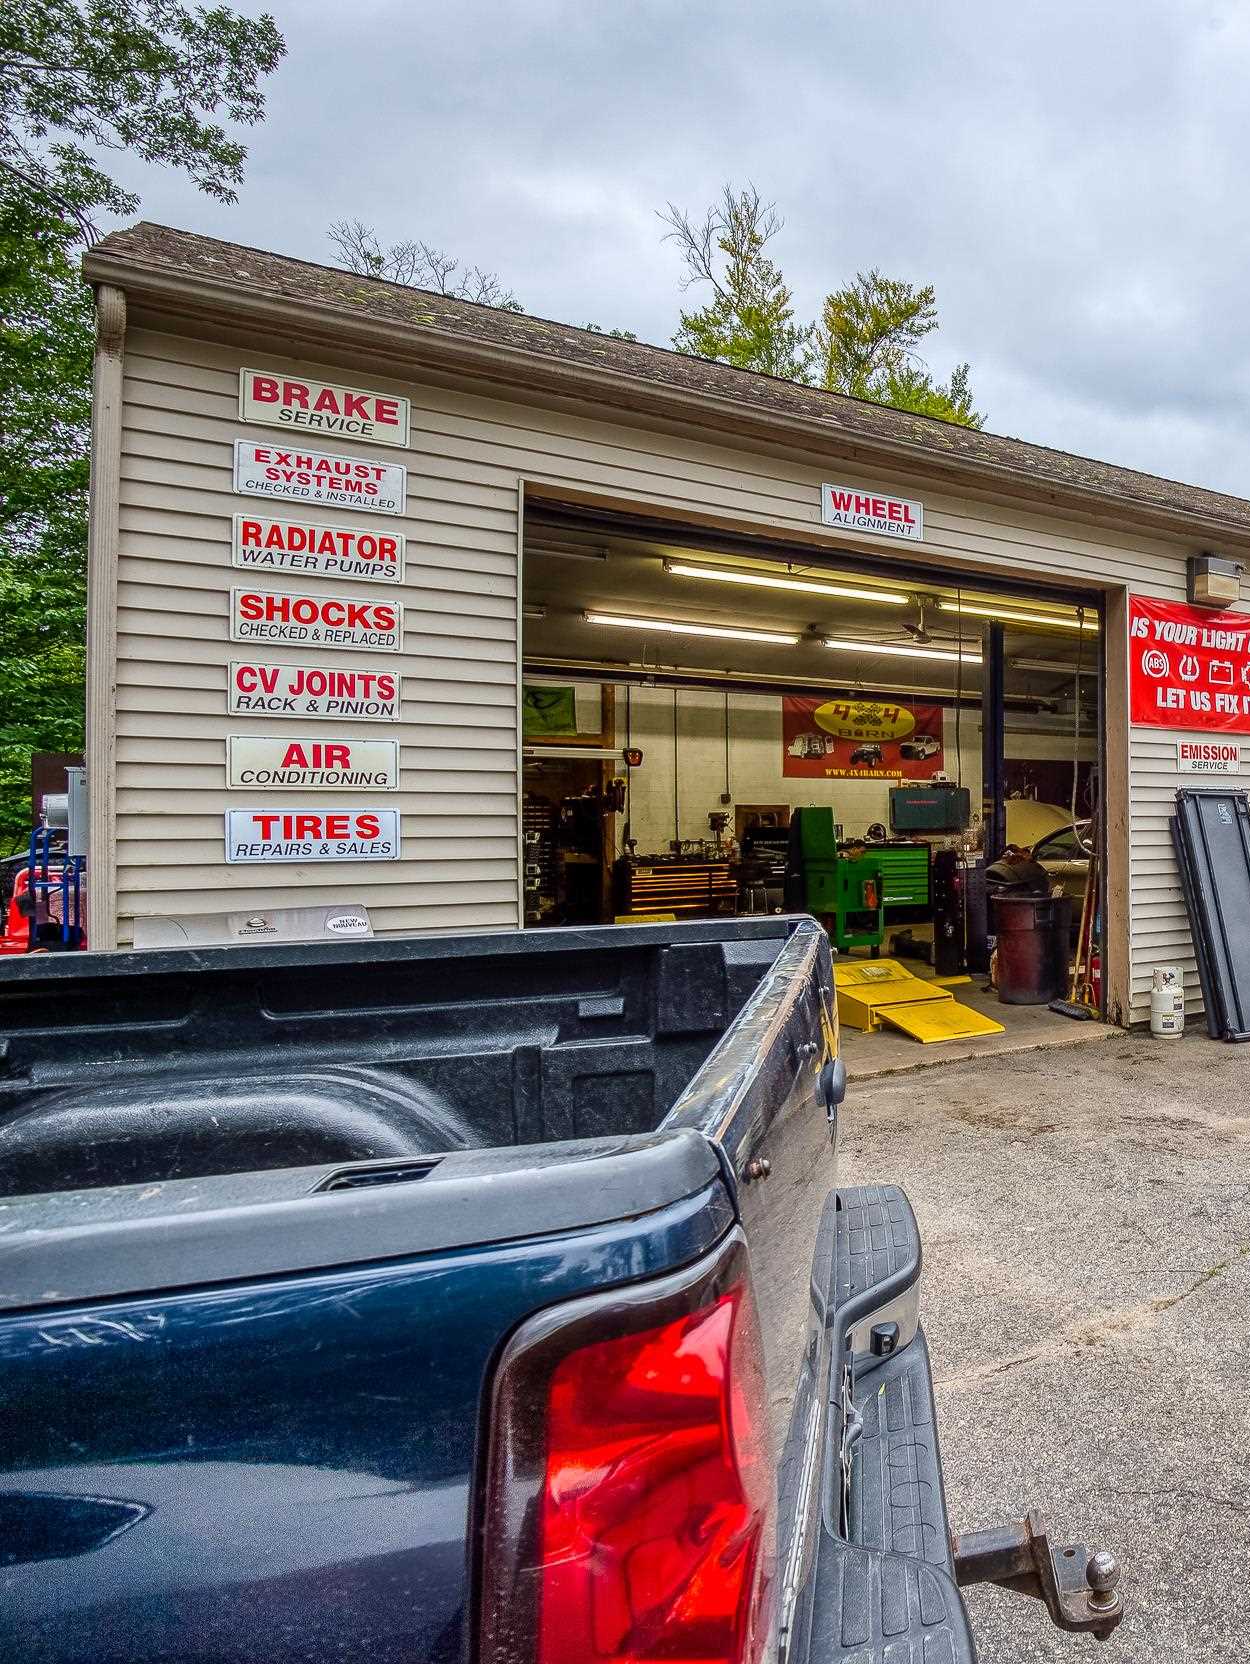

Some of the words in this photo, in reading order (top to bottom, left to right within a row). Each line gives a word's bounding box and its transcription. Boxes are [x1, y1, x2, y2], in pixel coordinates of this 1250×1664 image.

[252, 375, 399, 426] BRAKE
[278, 408, 375, 436] SERVICE
[254, 448, 387, 481] EXHAUST
[245, 479, 310, 497] CHECKED
[314, 490, 323, 499] &
[326, 491, 395, 509] INSTALLED
[265, 467, 379, 495] SYSTEMS
[831, 490, 915, 524] WHEEL
[832, 512, 914, 535] ALIGNMENT
[241, 520, 397, 563] RADIATOR
[242, 549, 319, 569] WATER
[324, 558, 396, 577] PUMPS
[239, 593, 395, 631] SHOCKS
[239, 622, 308, 641] CHECKED
[312, 629, 321, 641] &
[324, 630, 396, 647] REPLACED
[1130, 616, 1150, 638] IS
[1154, 620, 1198, 646] YOUR
[1201, 628, 1246, 652] LIGHT
[1148, 657, 1164, 669] ABS
[236, 666, 280, 694] CV
[289, 669, 395, 701] JOINTS
[236, 696, 297, 712] RACK
[306, 699, 319, 713] &
[326, 701, 395, 716] PINION
[1156, 686, 1186, 709] LET
[1190, 690, 1211, 712] US
[1215, 693, 1239, 714] FIX
[280, 743, 351, 770] AIR
[1180, 743, 1238, 761] EMISSION
[1191, 760, 1229, 770] SERVICE
[240, 769, 388, 786] CONDITIONING
[252, 814, 380, 840] TIRES
[235, 842, 312, 857] REPAIRS
[319, 842, 331, 855] &
[336, 841, 391, 855] SALES
[332, 921, 368, 930] NOUVEAU
[339, 917, 358, 925] NEW
